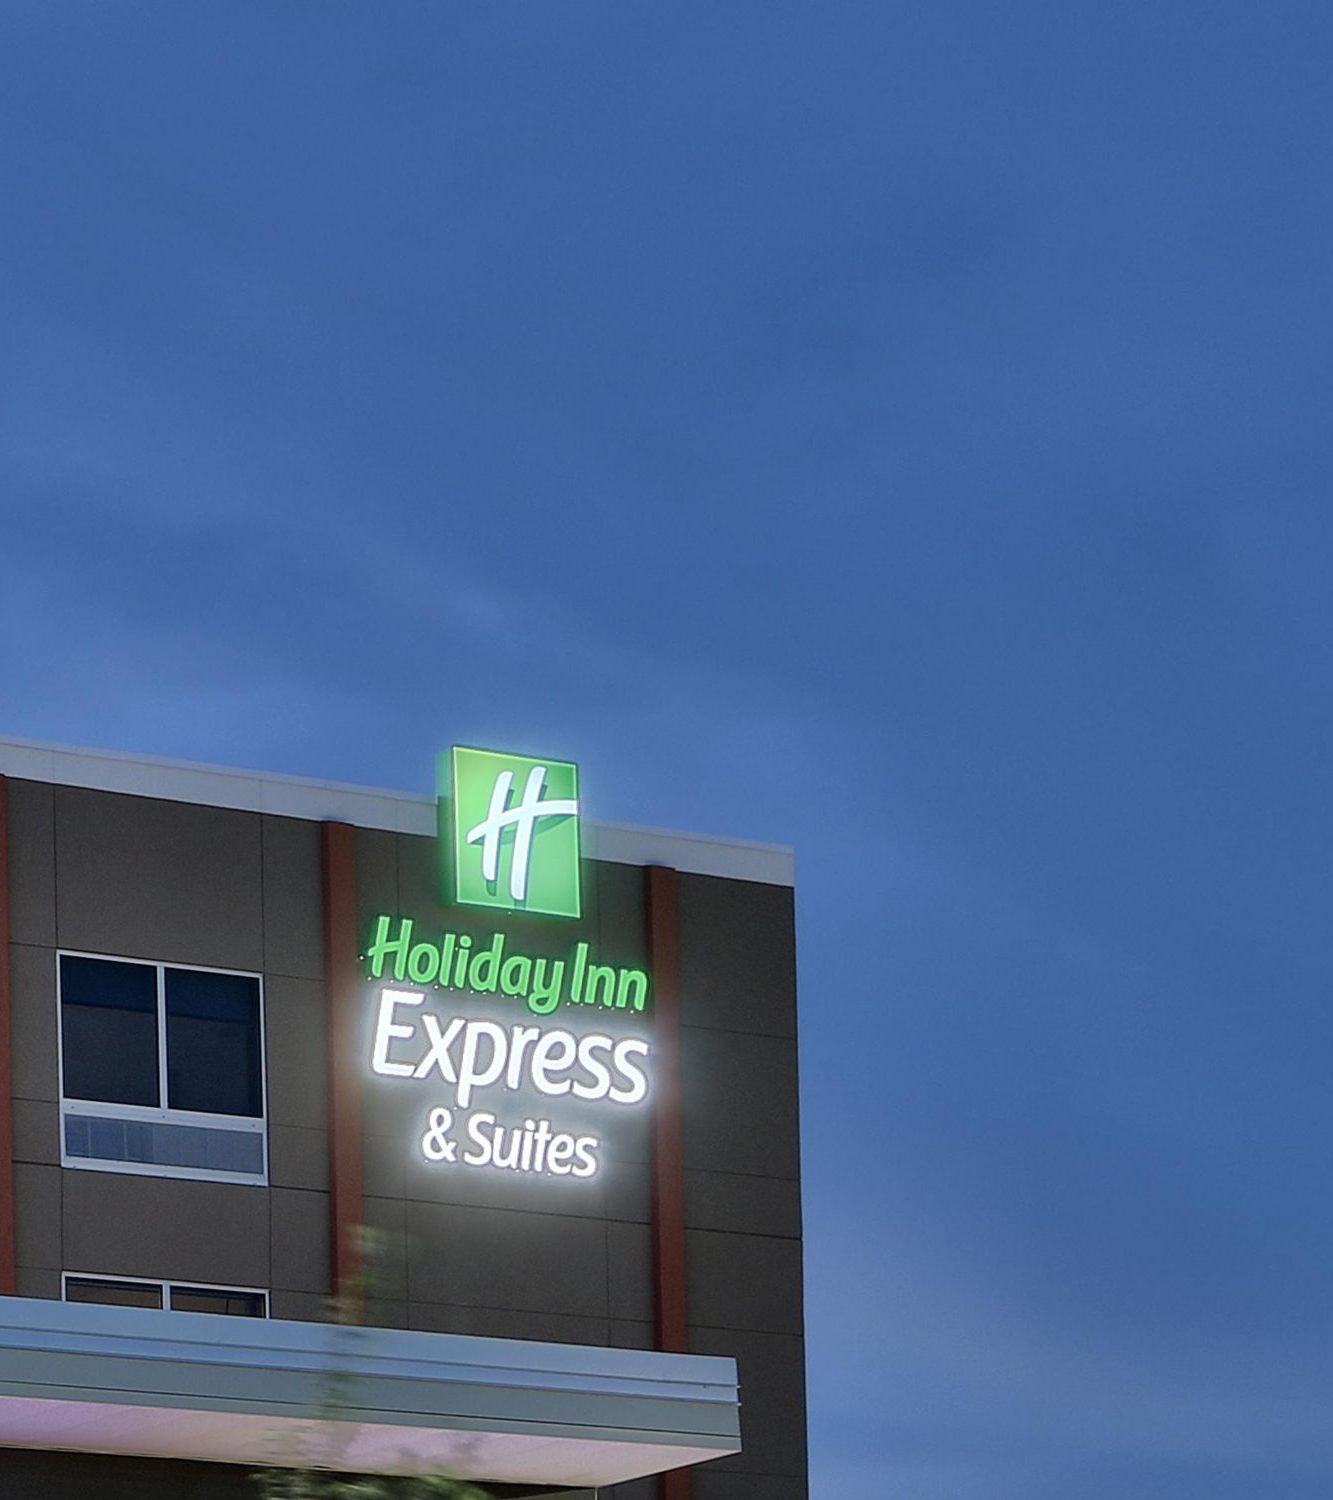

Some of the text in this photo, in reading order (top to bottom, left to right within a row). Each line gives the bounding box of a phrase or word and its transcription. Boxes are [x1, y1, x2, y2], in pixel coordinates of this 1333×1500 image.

[367, 914, 648, 1014] Holiday Inn
[370, 988, 650, 1108] Express
[421, 1106, 599, 1177] & Suites
